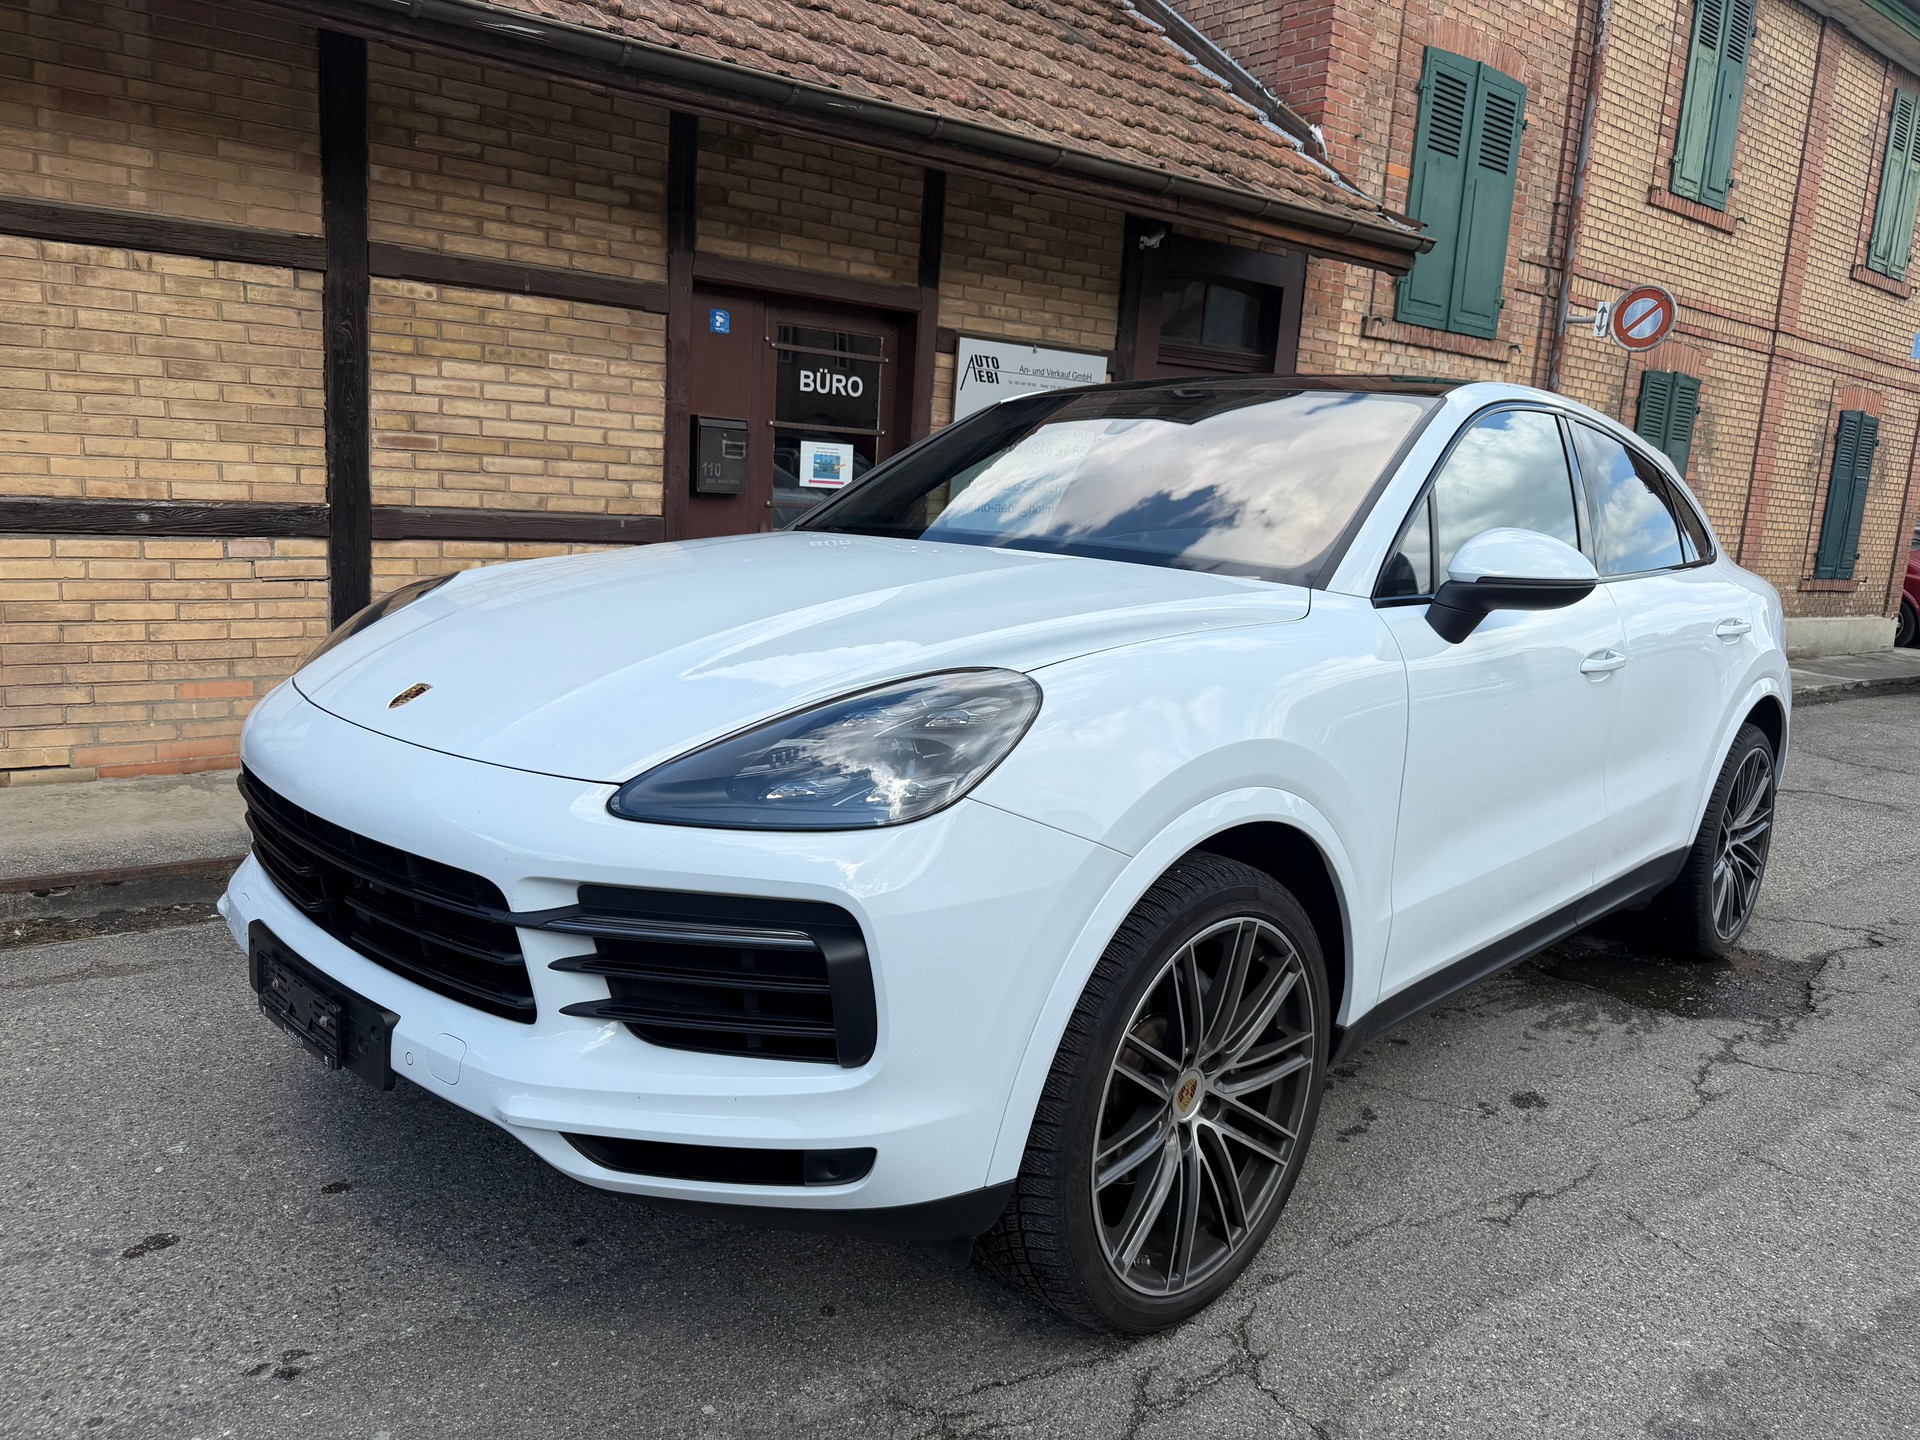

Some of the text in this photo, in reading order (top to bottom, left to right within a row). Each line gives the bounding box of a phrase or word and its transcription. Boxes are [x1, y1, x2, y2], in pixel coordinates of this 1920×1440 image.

[1019, 365, 1093, 382] An- und Verkauf GmbH
[799, 368, 864, 398] BÜRO
[702, 462, 721, 477] 110
